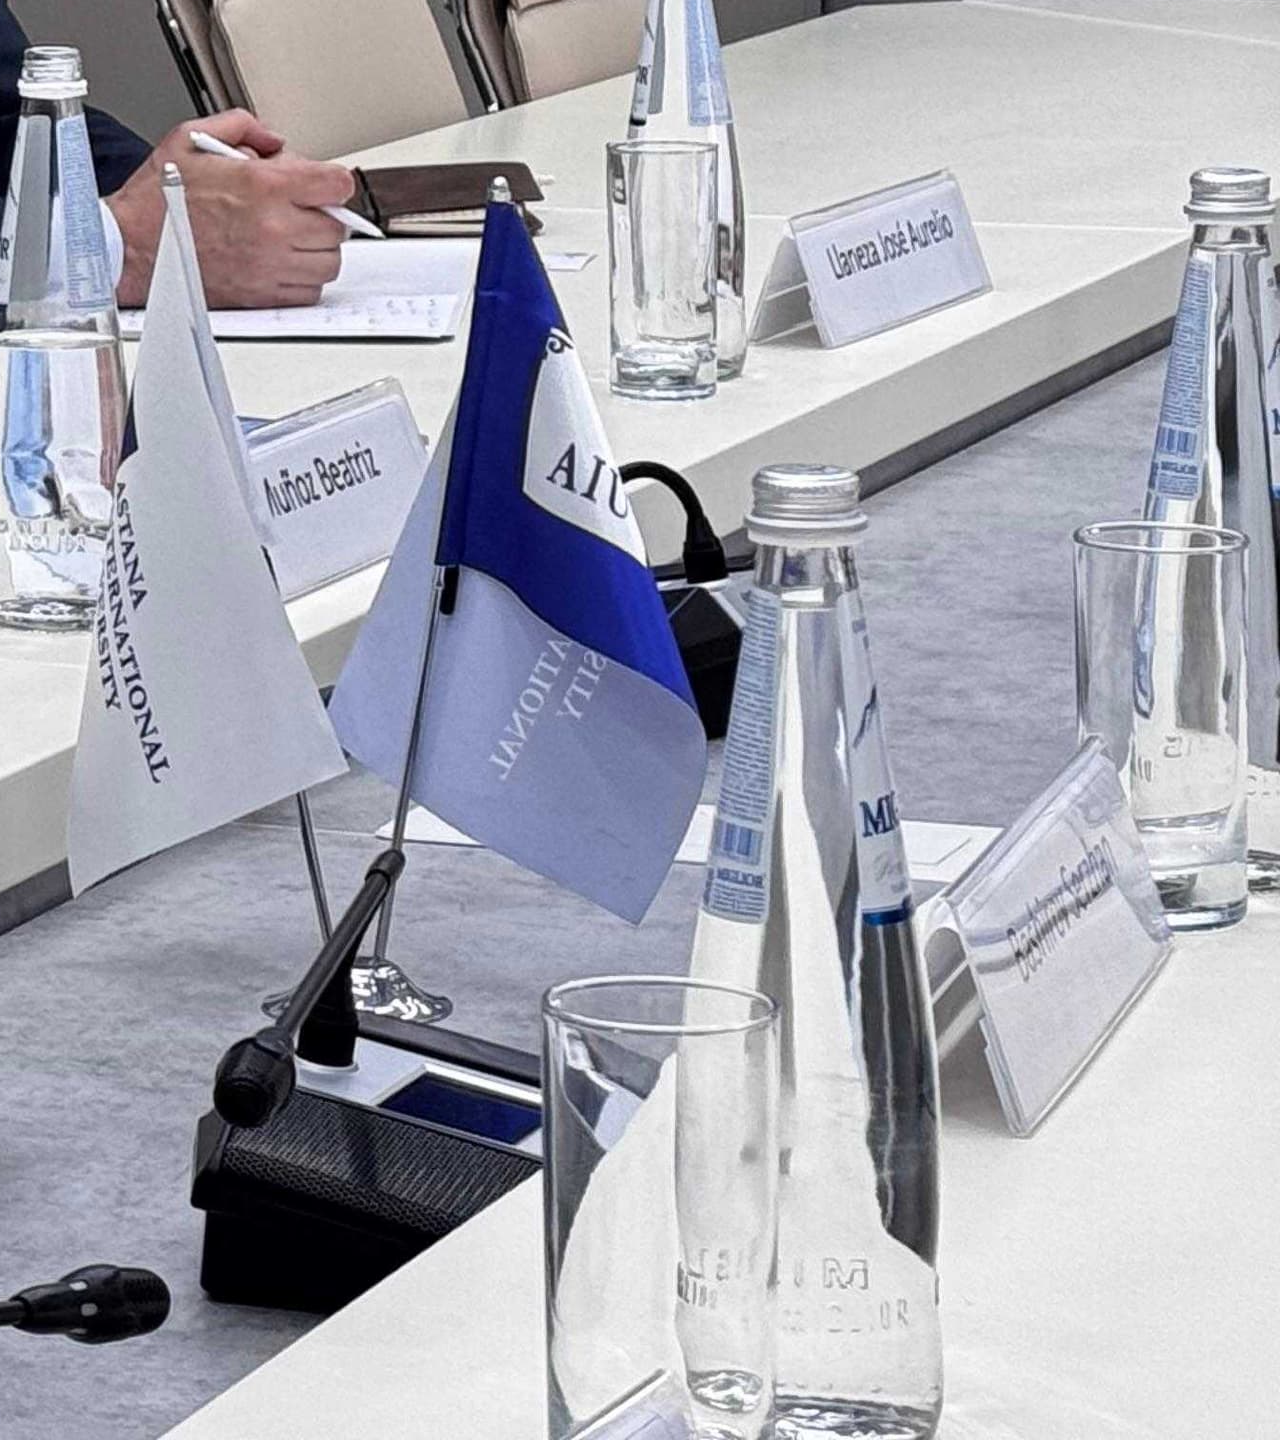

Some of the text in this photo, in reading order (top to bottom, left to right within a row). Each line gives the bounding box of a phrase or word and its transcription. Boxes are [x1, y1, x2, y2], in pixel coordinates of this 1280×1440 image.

[826, 208, 953, 280] Llaneza José Aurelio
[313, 441, 381, 496] Beatriz
